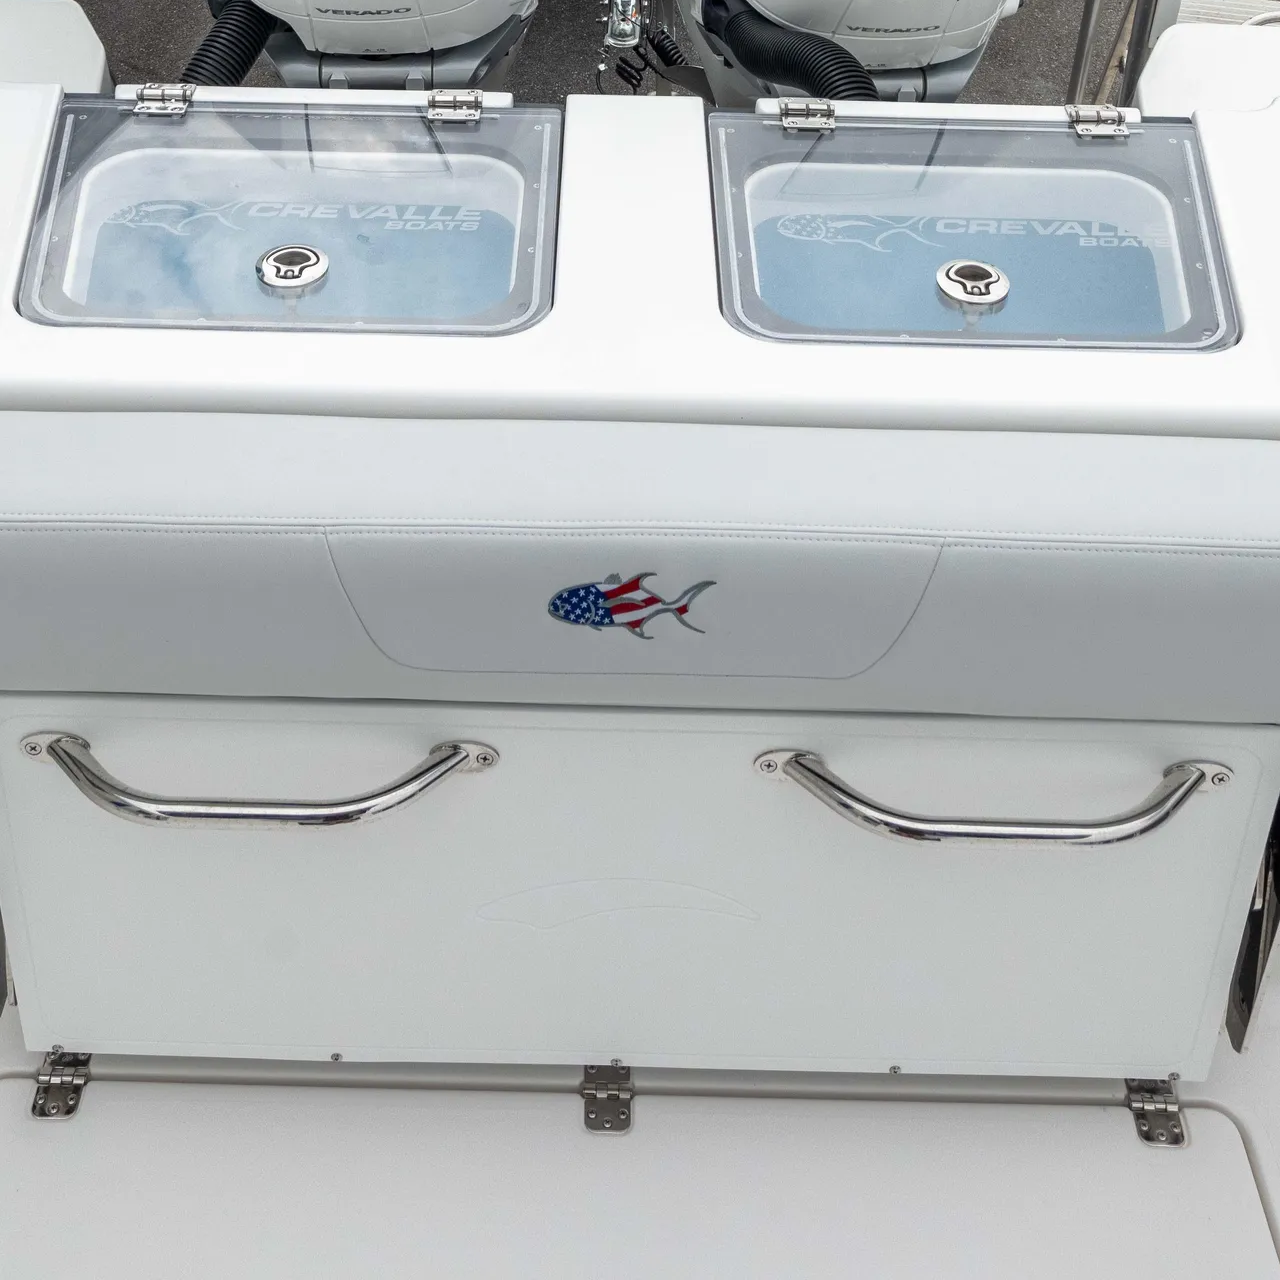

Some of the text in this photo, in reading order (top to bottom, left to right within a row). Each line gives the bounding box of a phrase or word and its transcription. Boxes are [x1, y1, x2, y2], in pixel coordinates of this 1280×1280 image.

[315, 7, 411, 16] VERADO
[846, 24, 940, 34] VERADO
[247, 202, 482, 221] CREVALLE
[383, 219, 480, 232] BOATS
